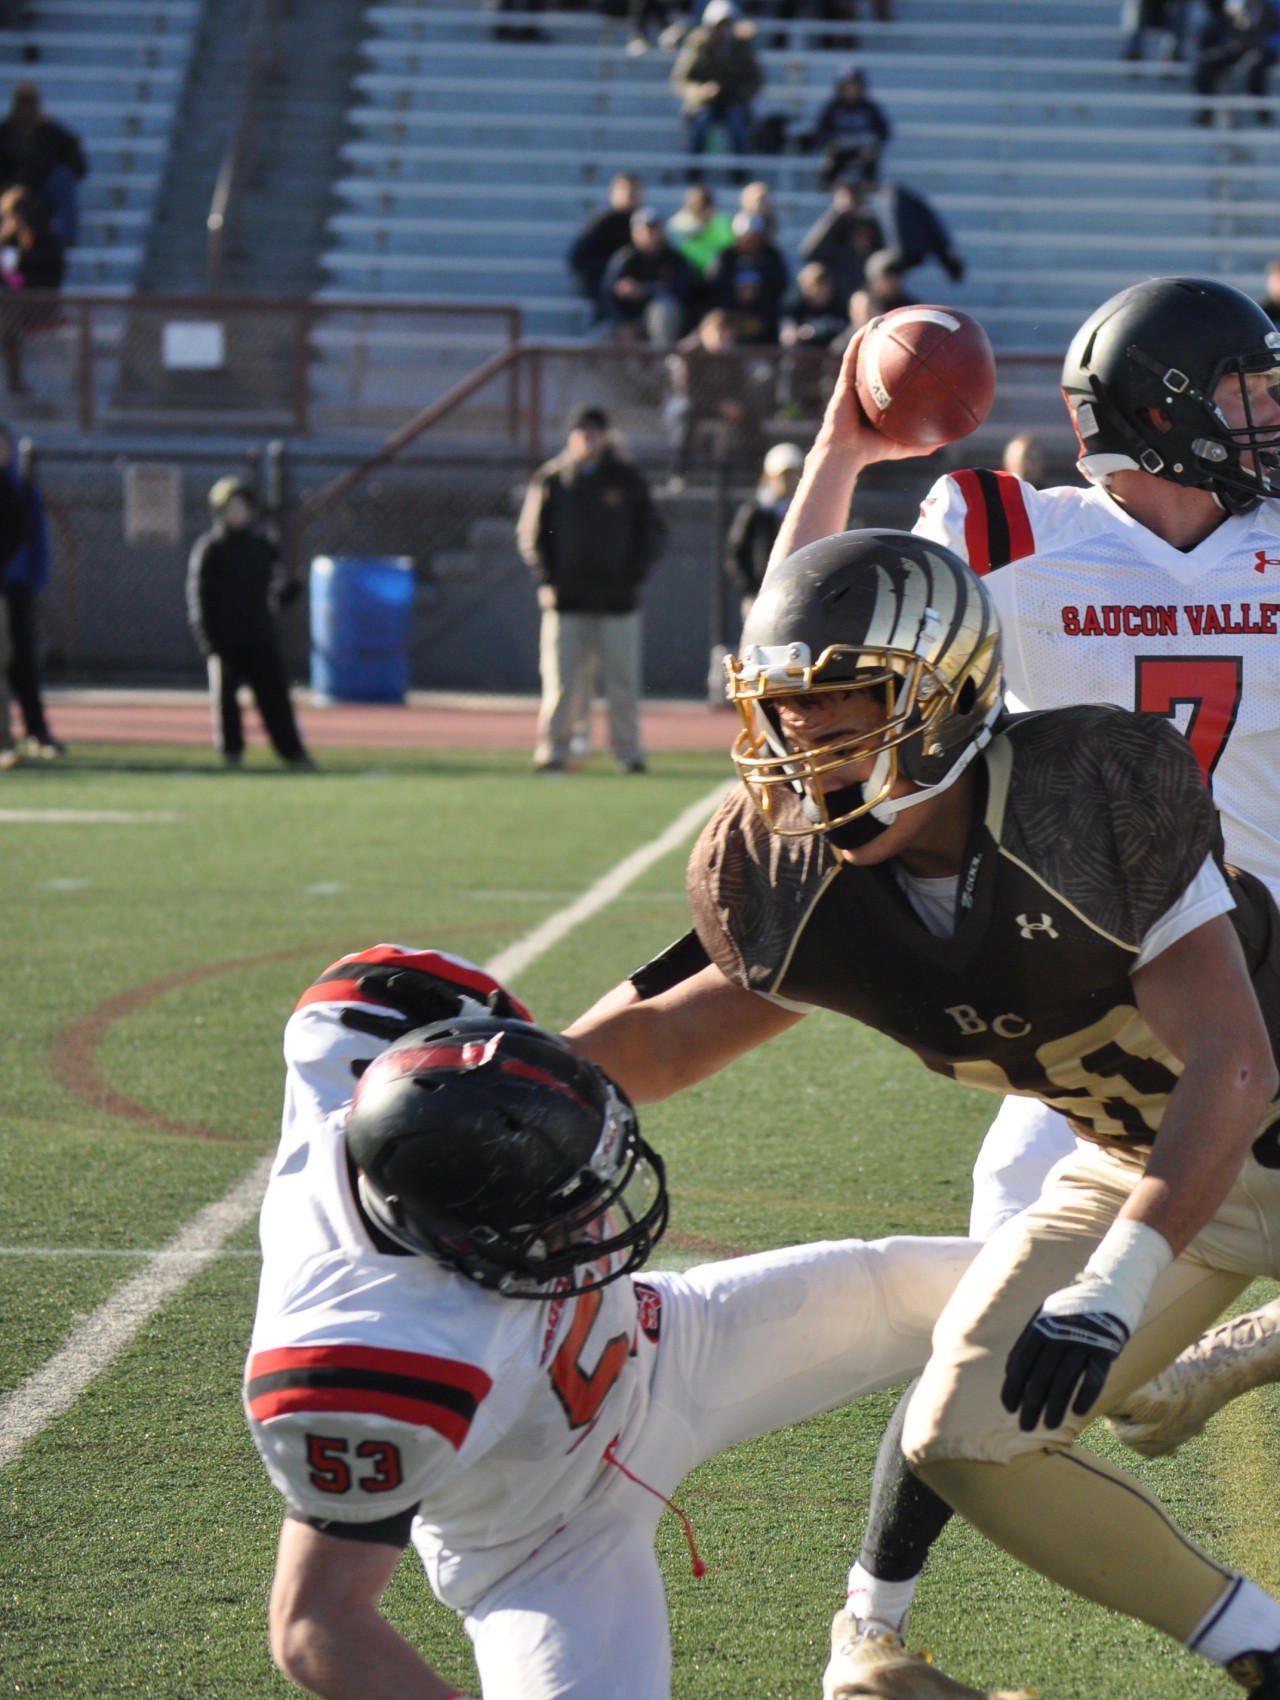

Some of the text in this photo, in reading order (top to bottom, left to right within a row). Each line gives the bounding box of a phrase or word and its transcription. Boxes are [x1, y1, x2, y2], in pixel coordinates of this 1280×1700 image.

[1061, 604, 1178, 637] SAUCON
[1134, 655, 1244, 800] 7
[944, 1003, 1033, 1040] BC
[304, 1432, 405, 1495] 53
